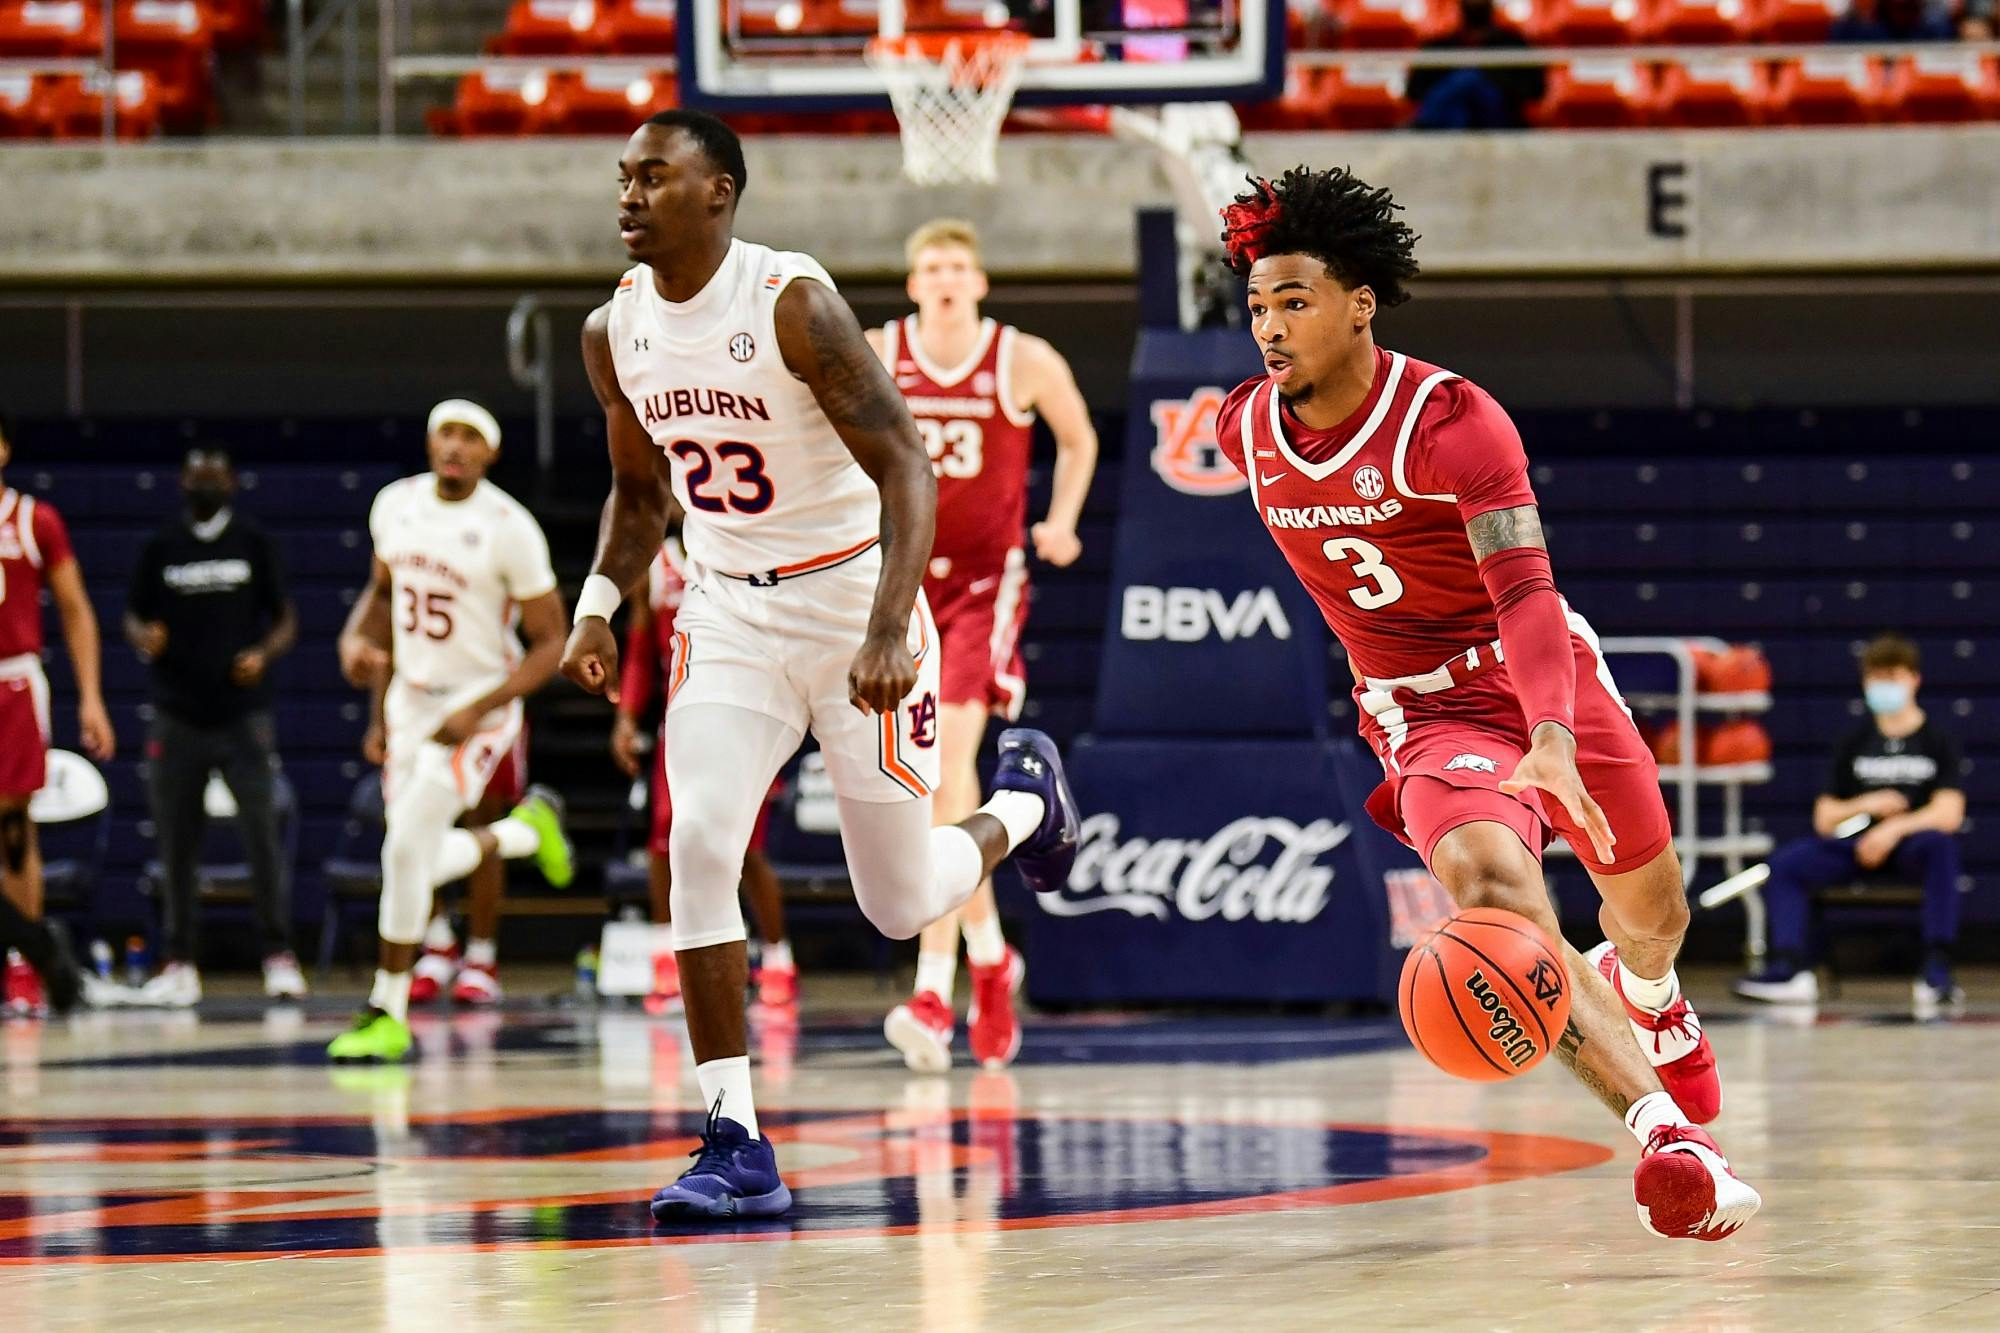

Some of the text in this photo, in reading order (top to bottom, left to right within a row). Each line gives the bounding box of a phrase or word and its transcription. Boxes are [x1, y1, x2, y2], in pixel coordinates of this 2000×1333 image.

[1646, 162, 1687, 239] E
[644, 388, 772, 427] AUBURN
[669, 440, 774, 515] 23
[1353, 465, 1384, 500] SEC
[1266, 498, 1403, 530] ARKANSAS
[1322, 537, 1405, 611] 3
[402, 585, 456, 641] 35
[1121, 584, 1292, 643] BBVA
[1465, 969, 1538, 1069] Wilson
